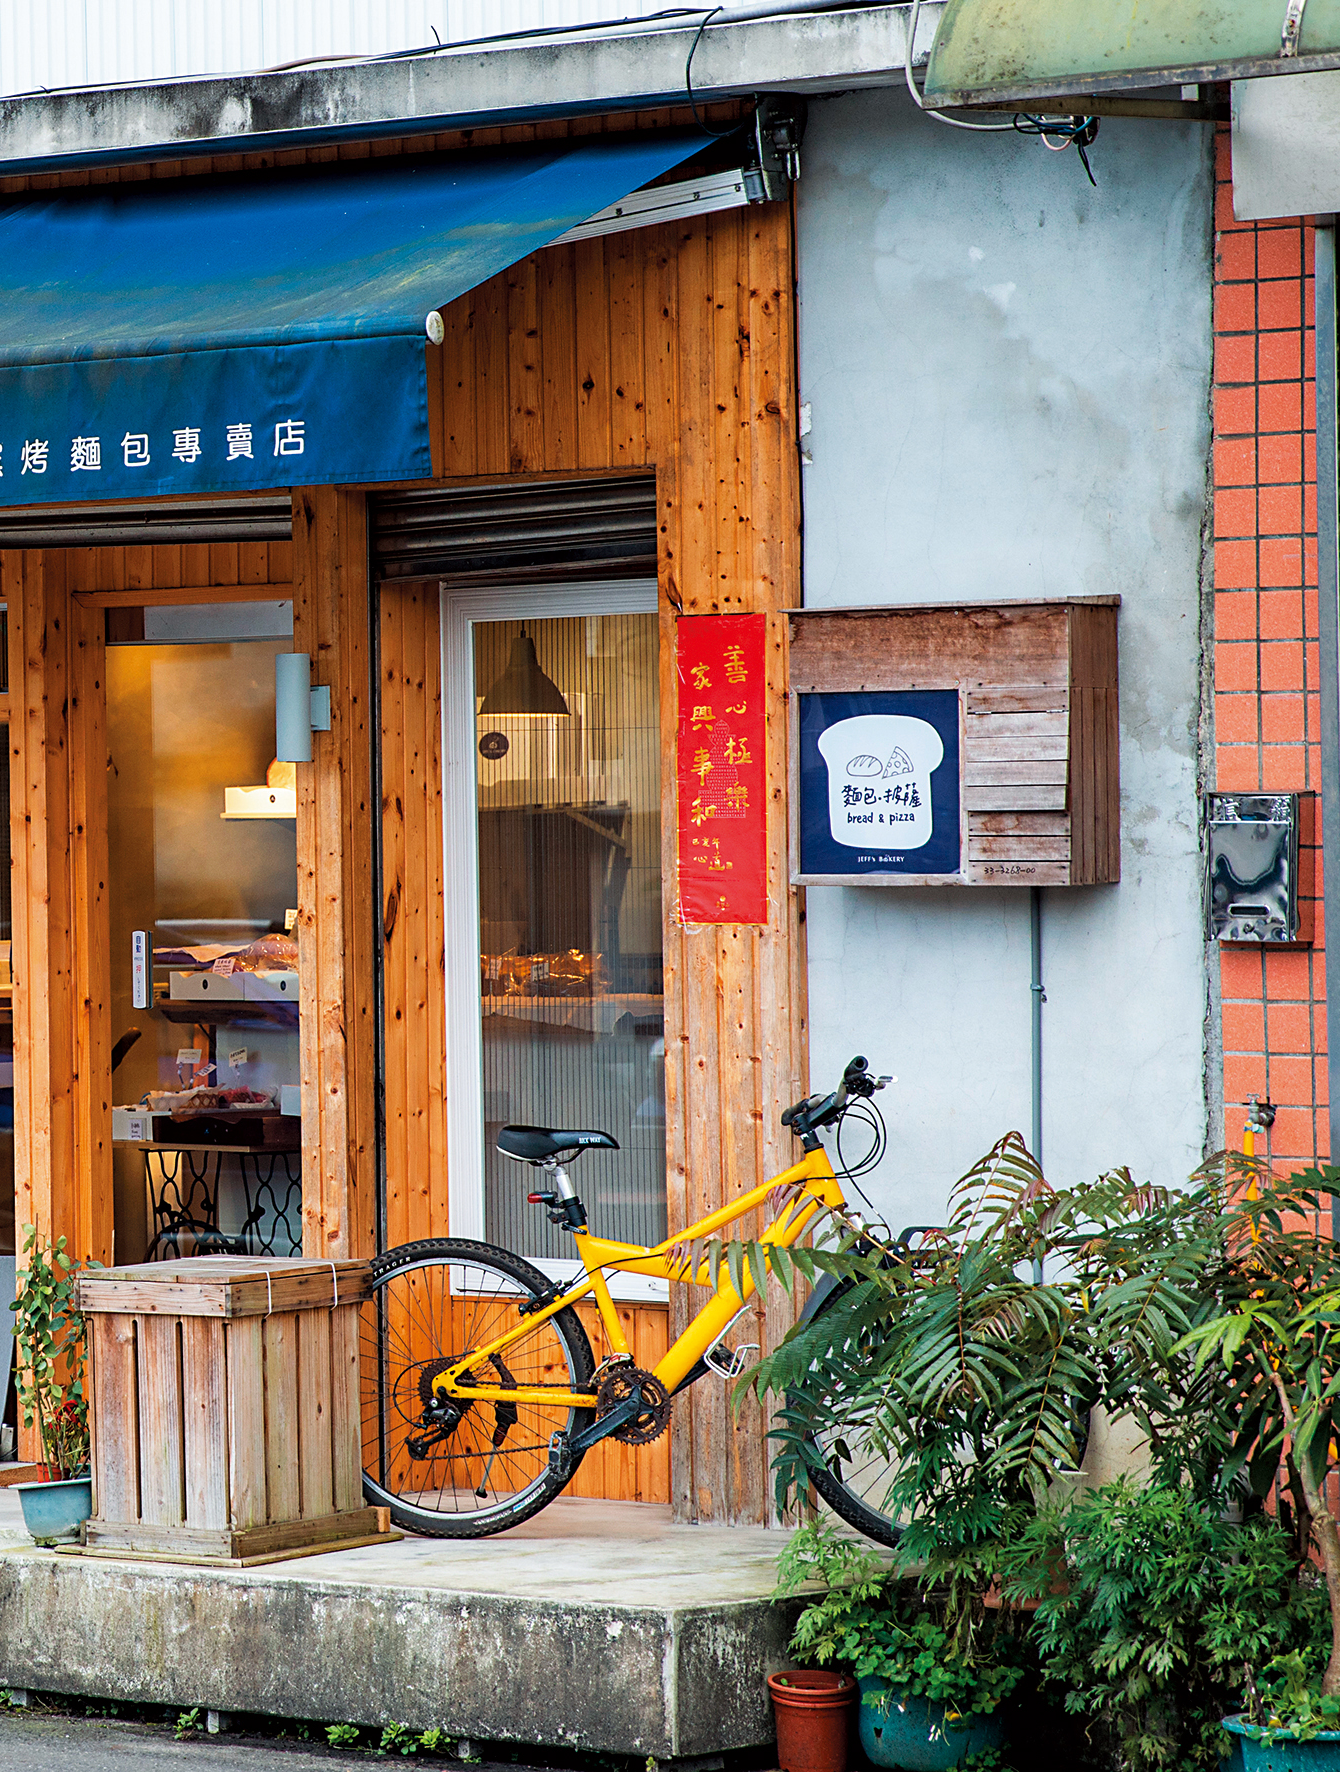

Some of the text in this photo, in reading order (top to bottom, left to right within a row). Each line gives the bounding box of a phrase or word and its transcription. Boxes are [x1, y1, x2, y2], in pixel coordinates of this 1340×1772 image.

[689, 662, 717, 827] 家興事和
[722, 645, 753, 811] 善心極樂
[847, 812, 916, 826] bread & pizza
